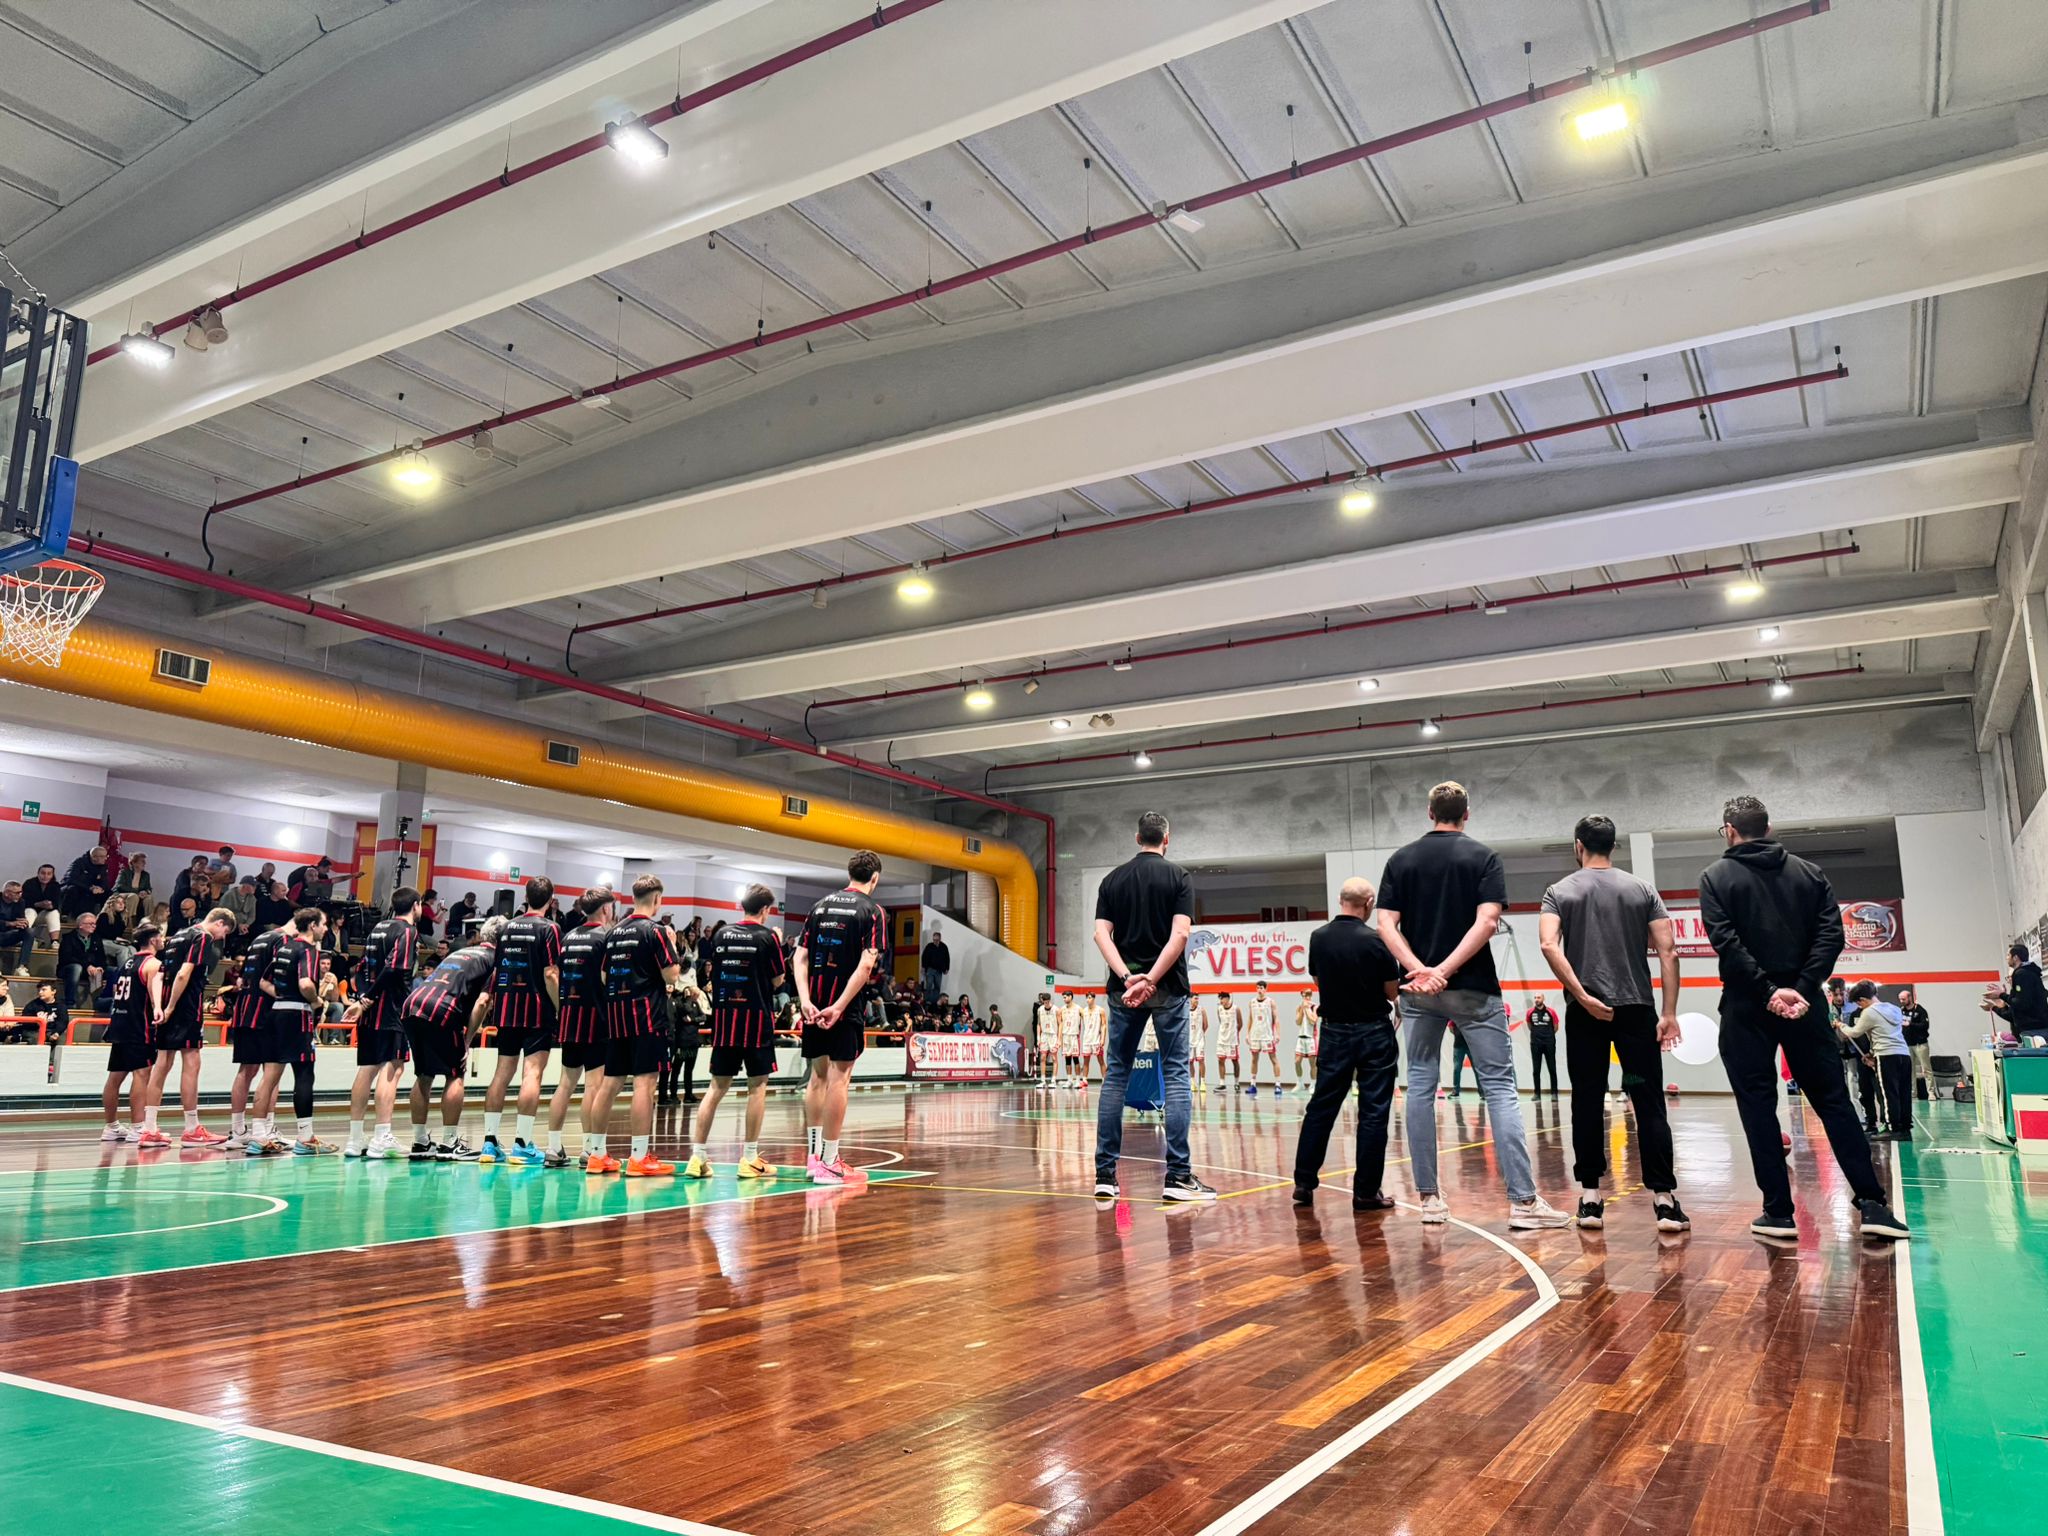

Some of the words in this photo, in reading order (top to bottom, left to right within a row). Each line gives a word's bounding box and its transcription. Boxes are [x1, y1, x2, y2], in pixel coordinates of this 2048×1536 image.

[1222, 933, 1248, 945] Vun,
[1251, 932, 1270, 945] du,
[1273, 932, 1297, 942] tri...
[1207, 945, 1306, 976] VLESC
[113, 976, 132, 1001] 33
[927, 1042, 959, 1062] SEMPRE
[962, 1043, 975, 1062] CON
